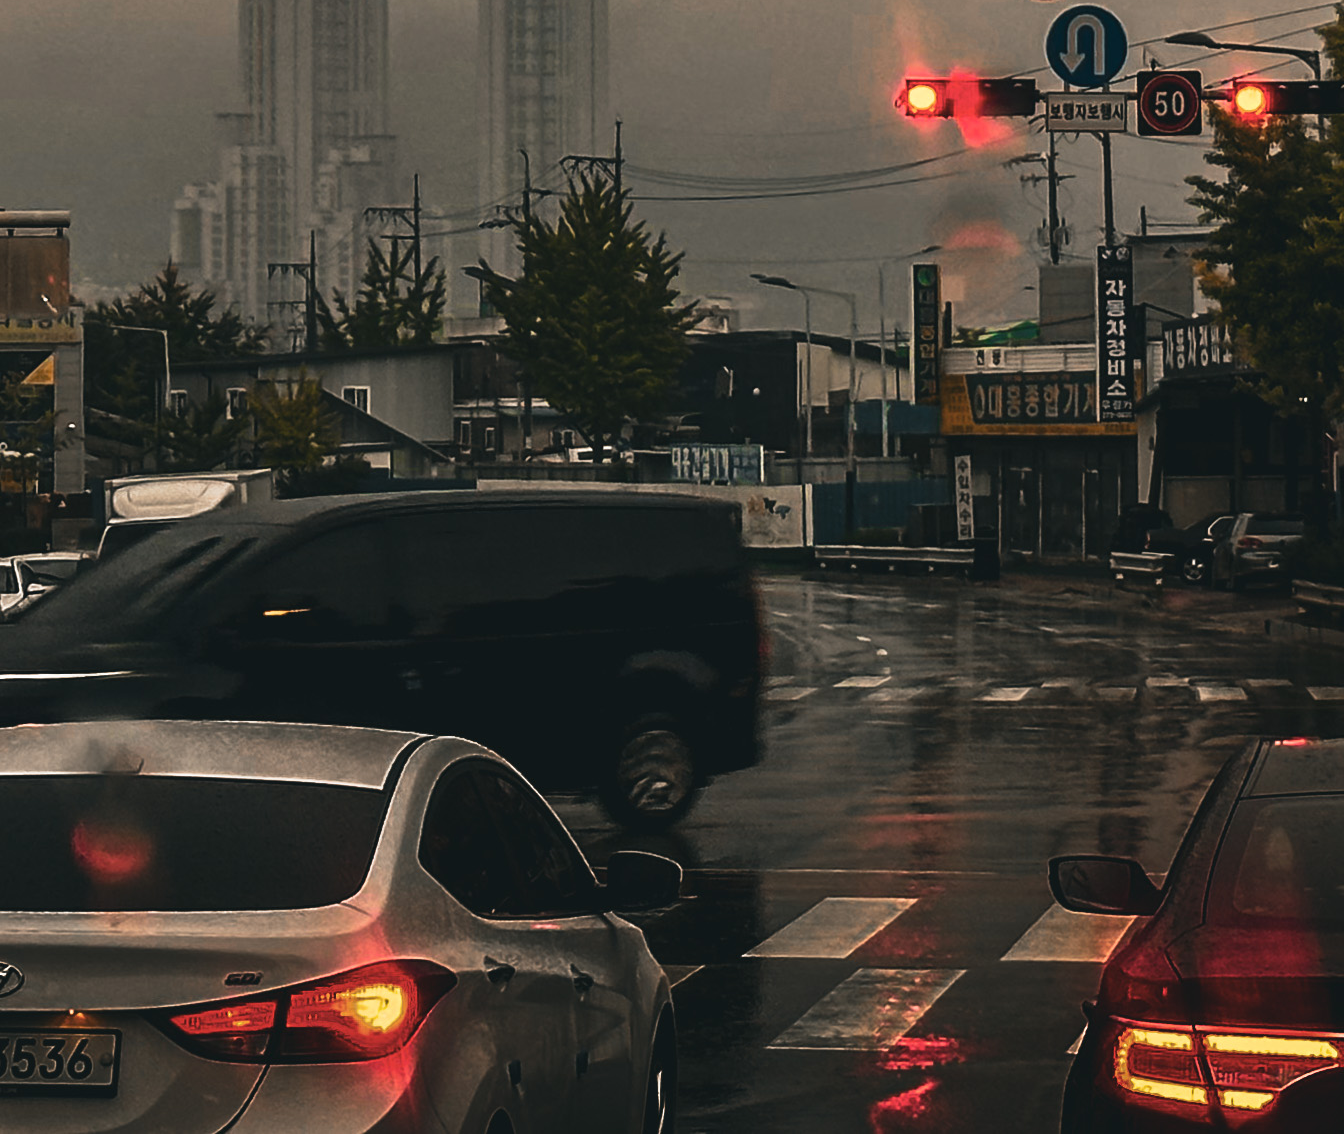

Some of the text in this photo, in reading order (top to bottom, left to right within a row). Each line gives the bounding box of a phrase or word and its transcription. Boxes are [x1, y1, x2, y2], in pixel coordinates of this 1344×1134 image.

[1050, 101, 1124, 121] 보행자보행시
[1154, 90, 1185, 116] 50
[1105, 279, 1128, 396] 자동차정비소
[958, 459, 972, 538] 수입차수리
